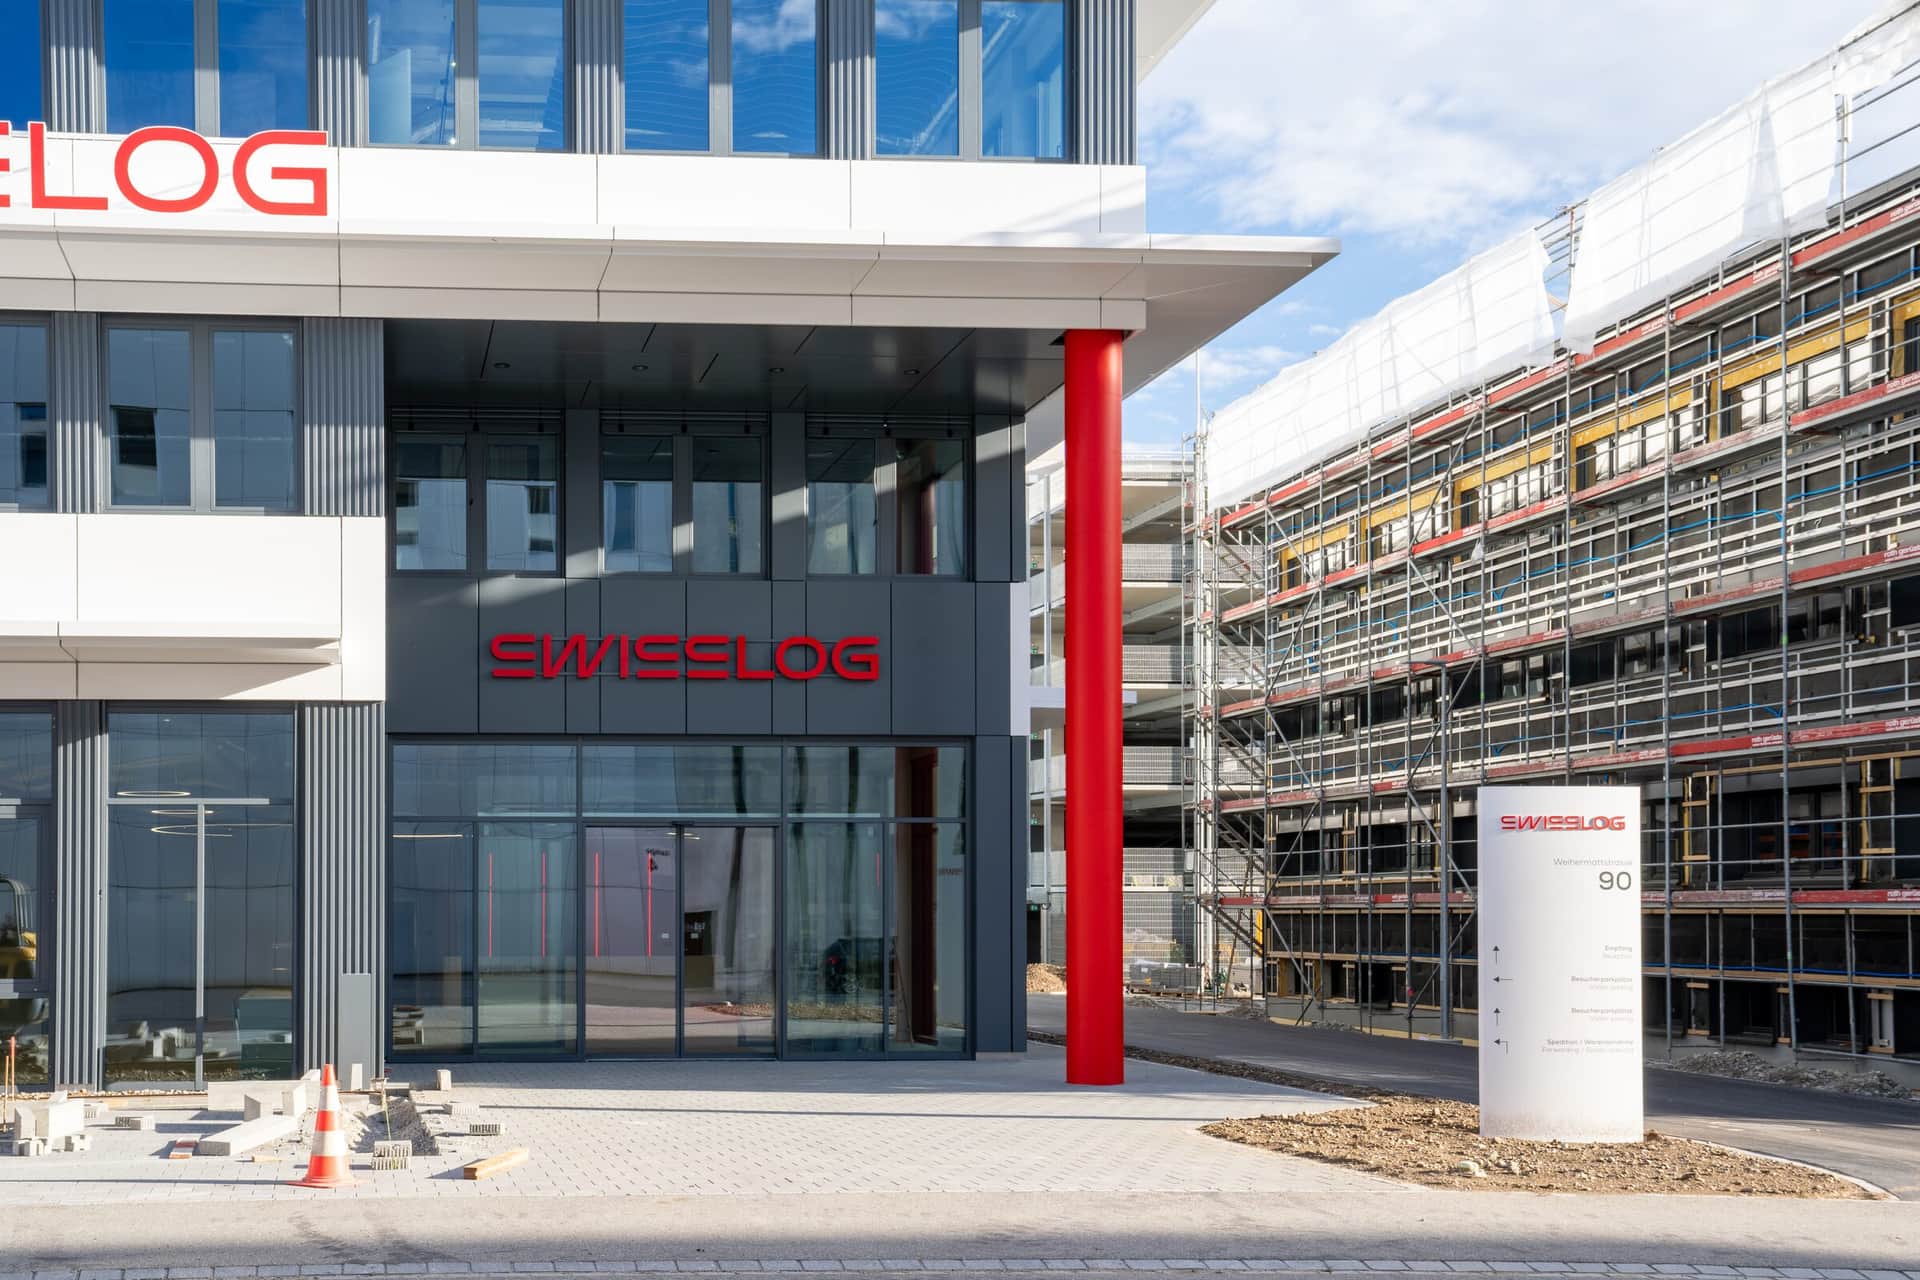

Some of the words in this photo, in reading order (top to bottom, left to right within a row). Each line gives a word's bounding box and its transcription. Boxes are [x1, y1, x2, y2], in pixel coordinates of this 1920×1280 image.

[0, 121, 327, 216] LOG
[490, 633, 880, 681] SWISSLOG
[1501, 815, 1626, 831] SWISSLOG
[1599, 871, 1632, 890] 90
